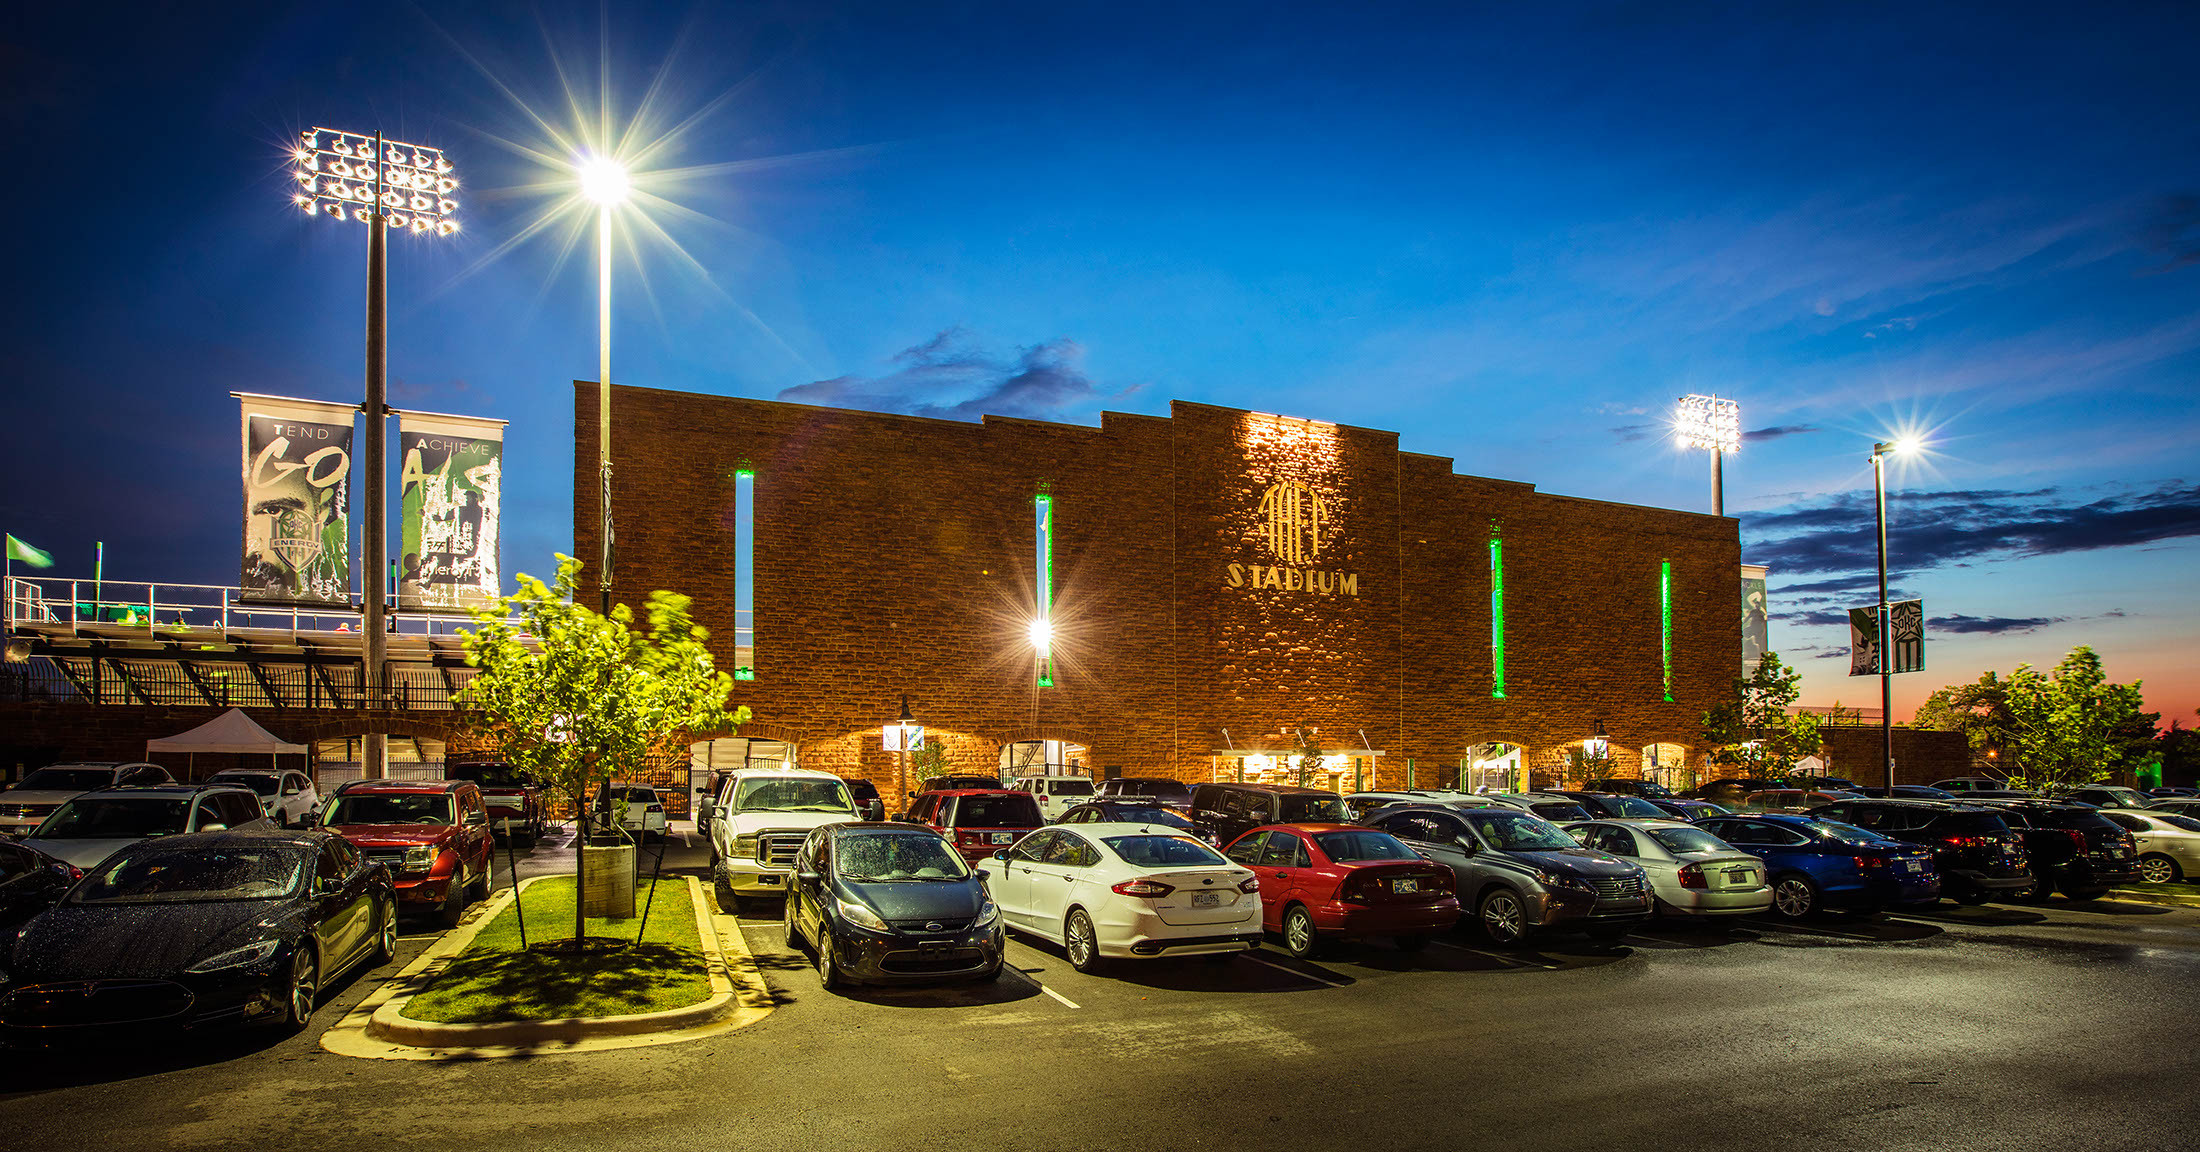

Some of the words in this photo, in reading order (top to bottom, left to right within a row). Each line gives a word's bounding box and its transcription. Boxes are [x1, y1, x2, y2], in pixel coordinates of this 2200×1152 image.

[273, 424, 329, 440] TEND
[416, 438, 490, 456] ACHIEVE
[251, 436, 350, 490] GO
[1226, 562, 1358, 596] STADIUM
[1898, 615, 1916, 631] OKC
